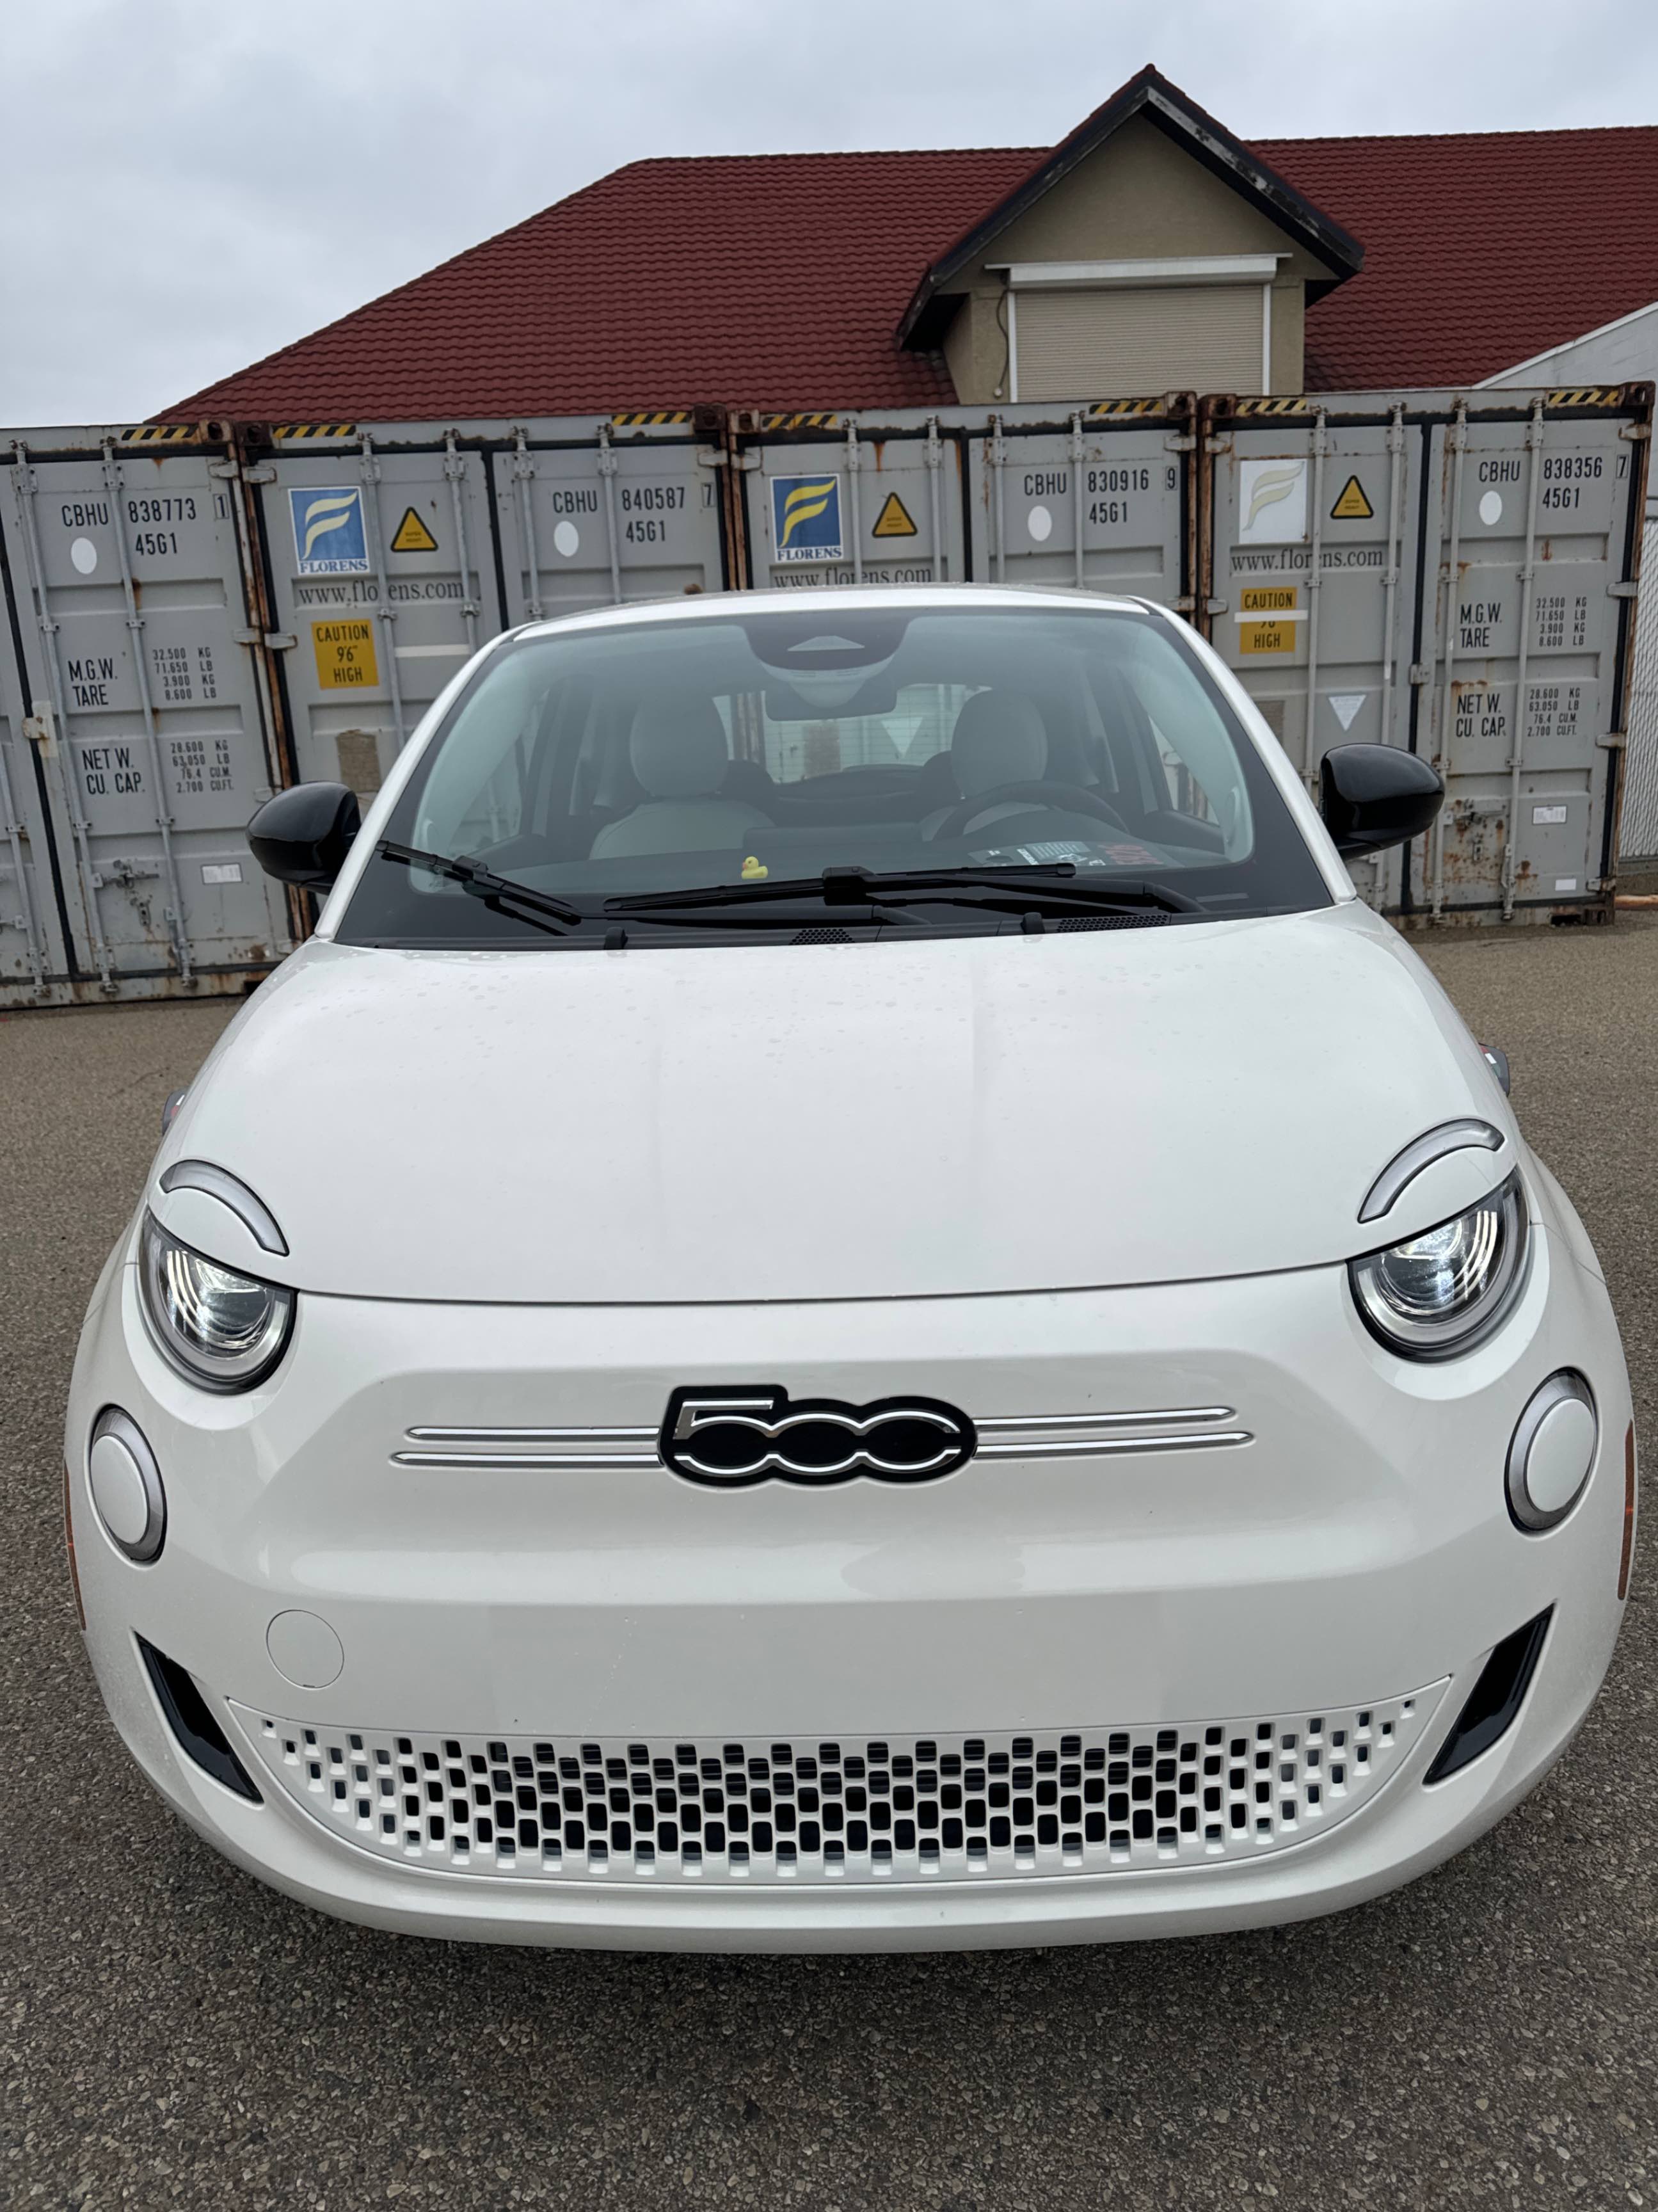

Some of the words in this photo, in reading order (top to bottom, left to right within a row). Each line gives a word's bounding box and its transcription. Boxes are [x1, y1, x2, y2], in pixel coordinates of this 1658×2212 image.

[1479, 461, 1520, 482] CBHU
[1544, 457, 1602, 479] 838356
[1619, 456, 1627, 476] 7
[1024, 473, 1067, 495] CBHU
[1088, 469, 1149, 493] 830916
[1168, 468, 1176, 489] 9
[554, 490, 597, 513] CBHU
[622, 487, 685, 511] 840587
[705, 485, 712, 505] 7
[1543, 488, 1580, 508] 45G1
[62, 503, 108, 526] CBHU
[128, 499, 196, 522] 838773
[217, 495, 225, 518] 1
[1090, 502, 1128, 524] 45G1
[626, 520, 666, 542] 45G1
[136, 533, 177, 555] 45G1
[777, 547, 842, 561] FLORENS
[299, 559, 367, 572] FLORENS
[1245, 593, 1293, 609] CAUTION
[1575, 597, 1587, 607] KG
[1460, 603, 1502, 624] M.G.W.
[1574, 609, 1586, 620] LB
[316, 625, 369, 643] CAUTION
[1574, 621, 1585, 633] KG
[1254, 634, 1280, 648] HIGH
[1460, 627, 1490, 648] TARE
[1573, 634, 1584, 646] LB
[198, 646, 211, 658] KG
[68, 658, 118, 682] M.G.W.
[200, 660, 213, 672] LB
[333, 667, 363, 683] HIGH
[202, 673, 215, 685] KG
[72, 685, 109, 707] TARE
[203, 687, 217, 699] LB
[1569, 687, 1580, 698] KG
[1456, 694, 1483, 714] NET
[1487, 693, 1501, 713] W.
[1568, 700, 1579, 710] LB
[1456, 718, 1474, 737] CU.
[82, 749, 110, 770] NET
[115, 747, 134, 768] W.
[217, 753, 230, 764] LB
[86, 774, 110, 795] CU.
[115, 772, 146, 793] CAP.
[674, 1399, 962, 1475] 500
